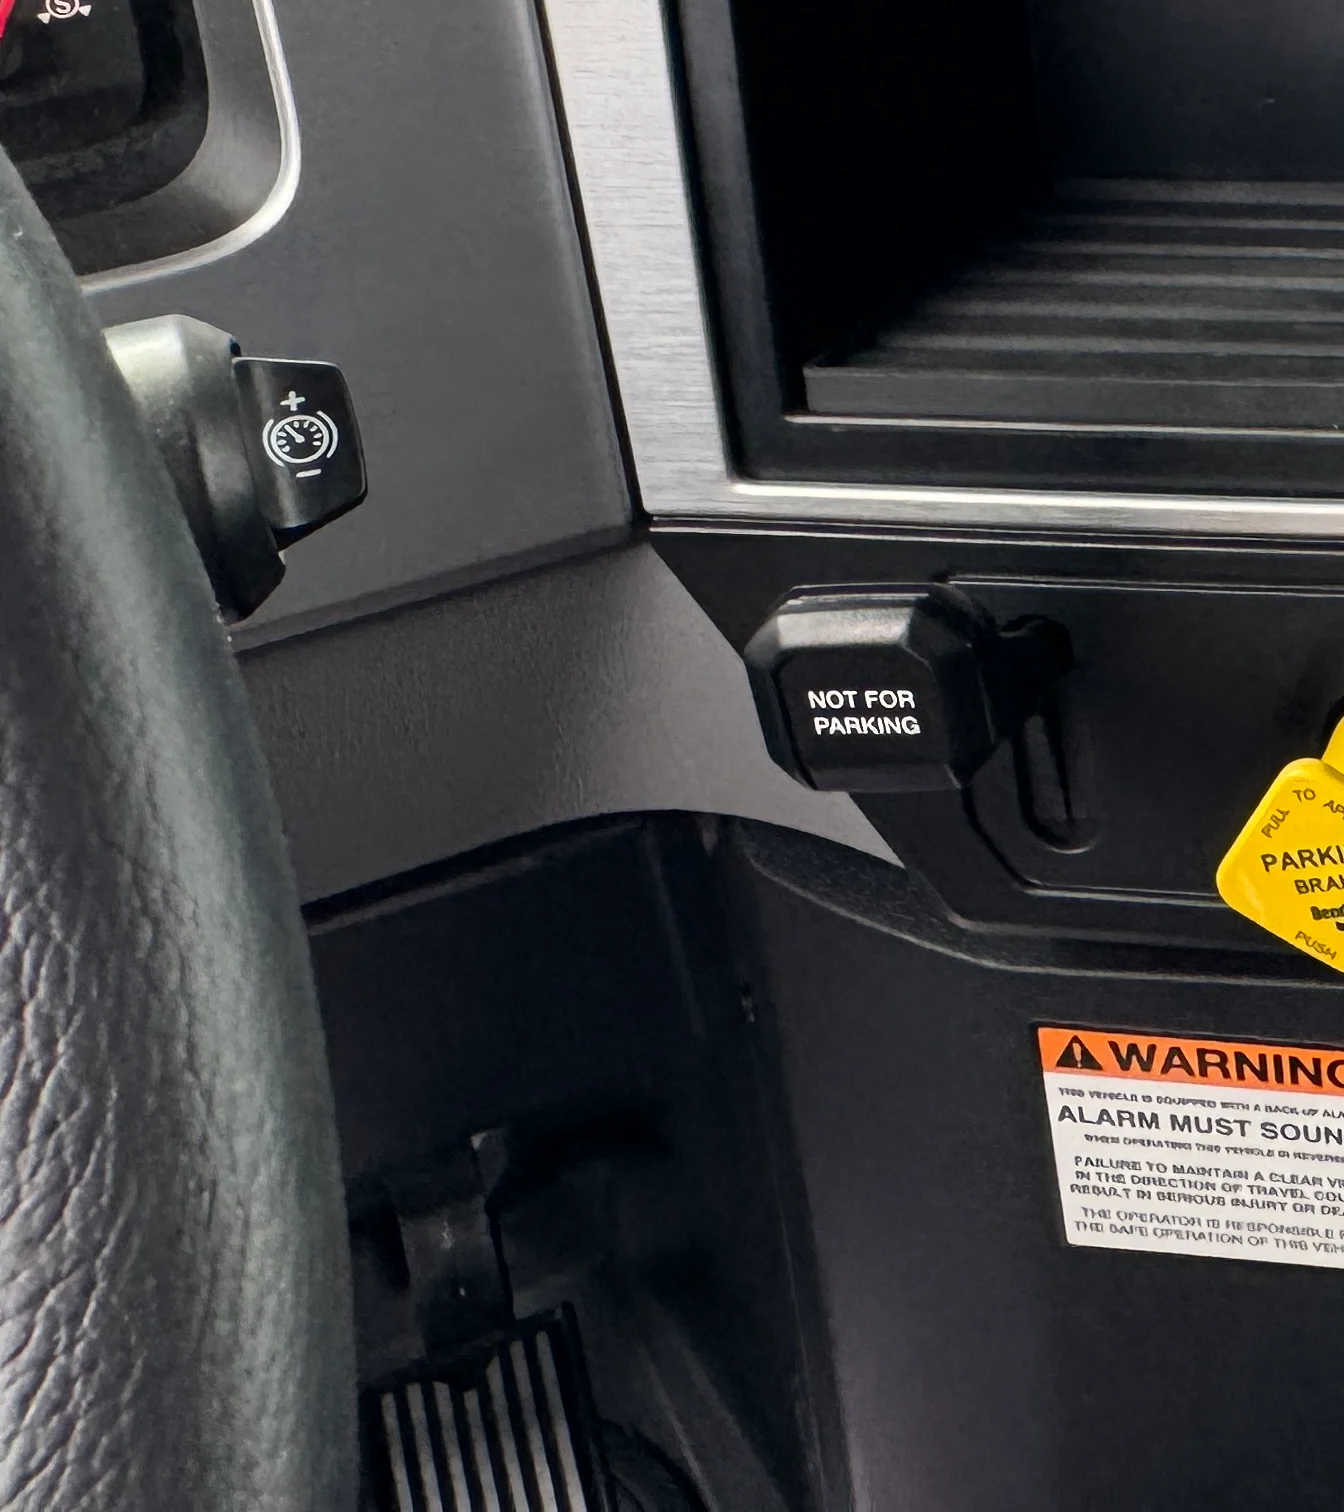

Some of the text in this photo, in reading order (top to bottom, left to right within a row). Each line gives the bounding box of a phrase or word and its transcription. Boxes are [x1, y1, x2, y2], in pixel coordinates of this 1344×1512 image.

[807, 690, 916, 709] NOT FOR
[813, 716, 921, 735] PARKING
[1261, 808, 1290, 838] PULL
[1292, 788, 1316, 802] TO
[1295, 931, 1337, 960] PUSH
[1058, 1105, 1160, 1130] ALARM
[1170, 1114, 1251, 1138] MUST
[1095, 1172, 1126, 1184] THE
[1221, 1182, 1242, 1194] OF
[1247, 1184, 1310, 1199] TRAVEL
[1146, 1161, 1167, 1174] TO
[1173, 1164, 1248, 1180] MAINTAIN
[1254, 1171, 1264, 1182] A
[1269, 1172, 1323, 1187] CLEAR
[1153, 1228, 1243, 1245] OPERATION
[1247, 1236, 1268, 1246] OF
